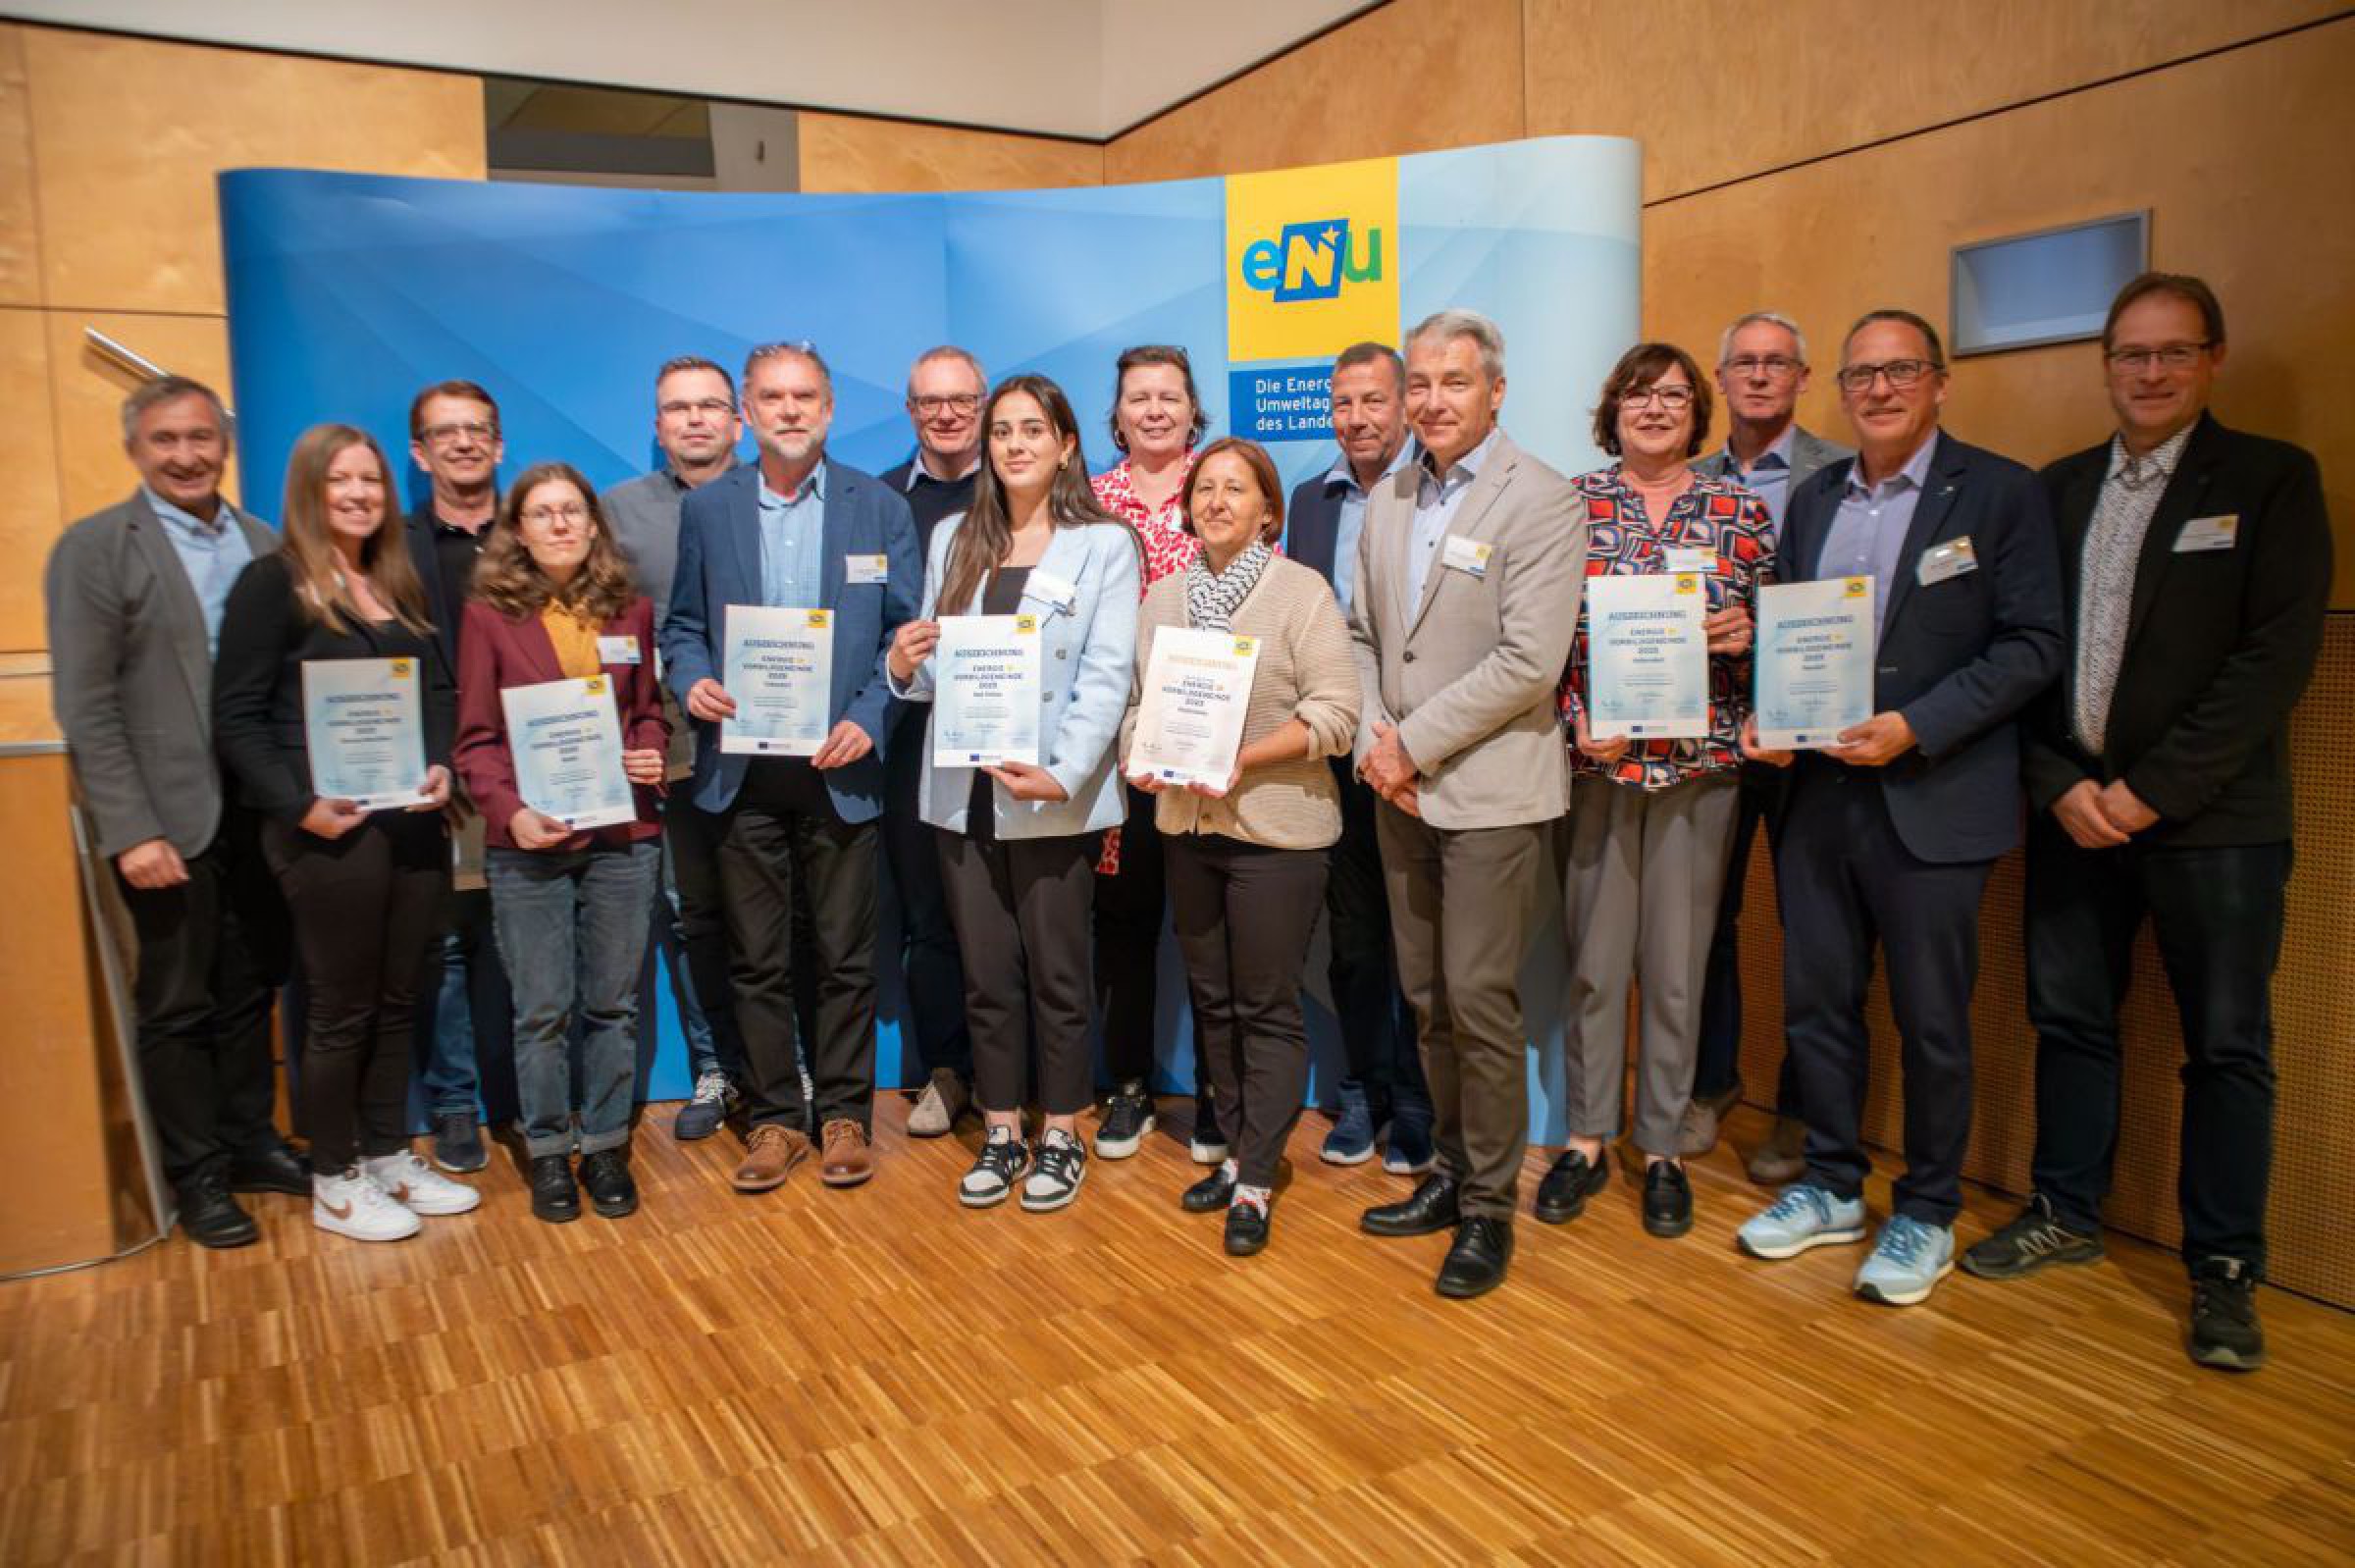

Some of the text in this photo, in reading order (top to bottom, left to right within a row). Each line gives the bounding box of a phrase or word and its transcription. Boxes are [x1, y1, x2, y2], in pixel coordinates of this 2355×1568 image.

[1256, 379, 1281, 393] Die
[1256, 396, 1331, 413] Umweltag
[1256, 416, 1282, 431] des
